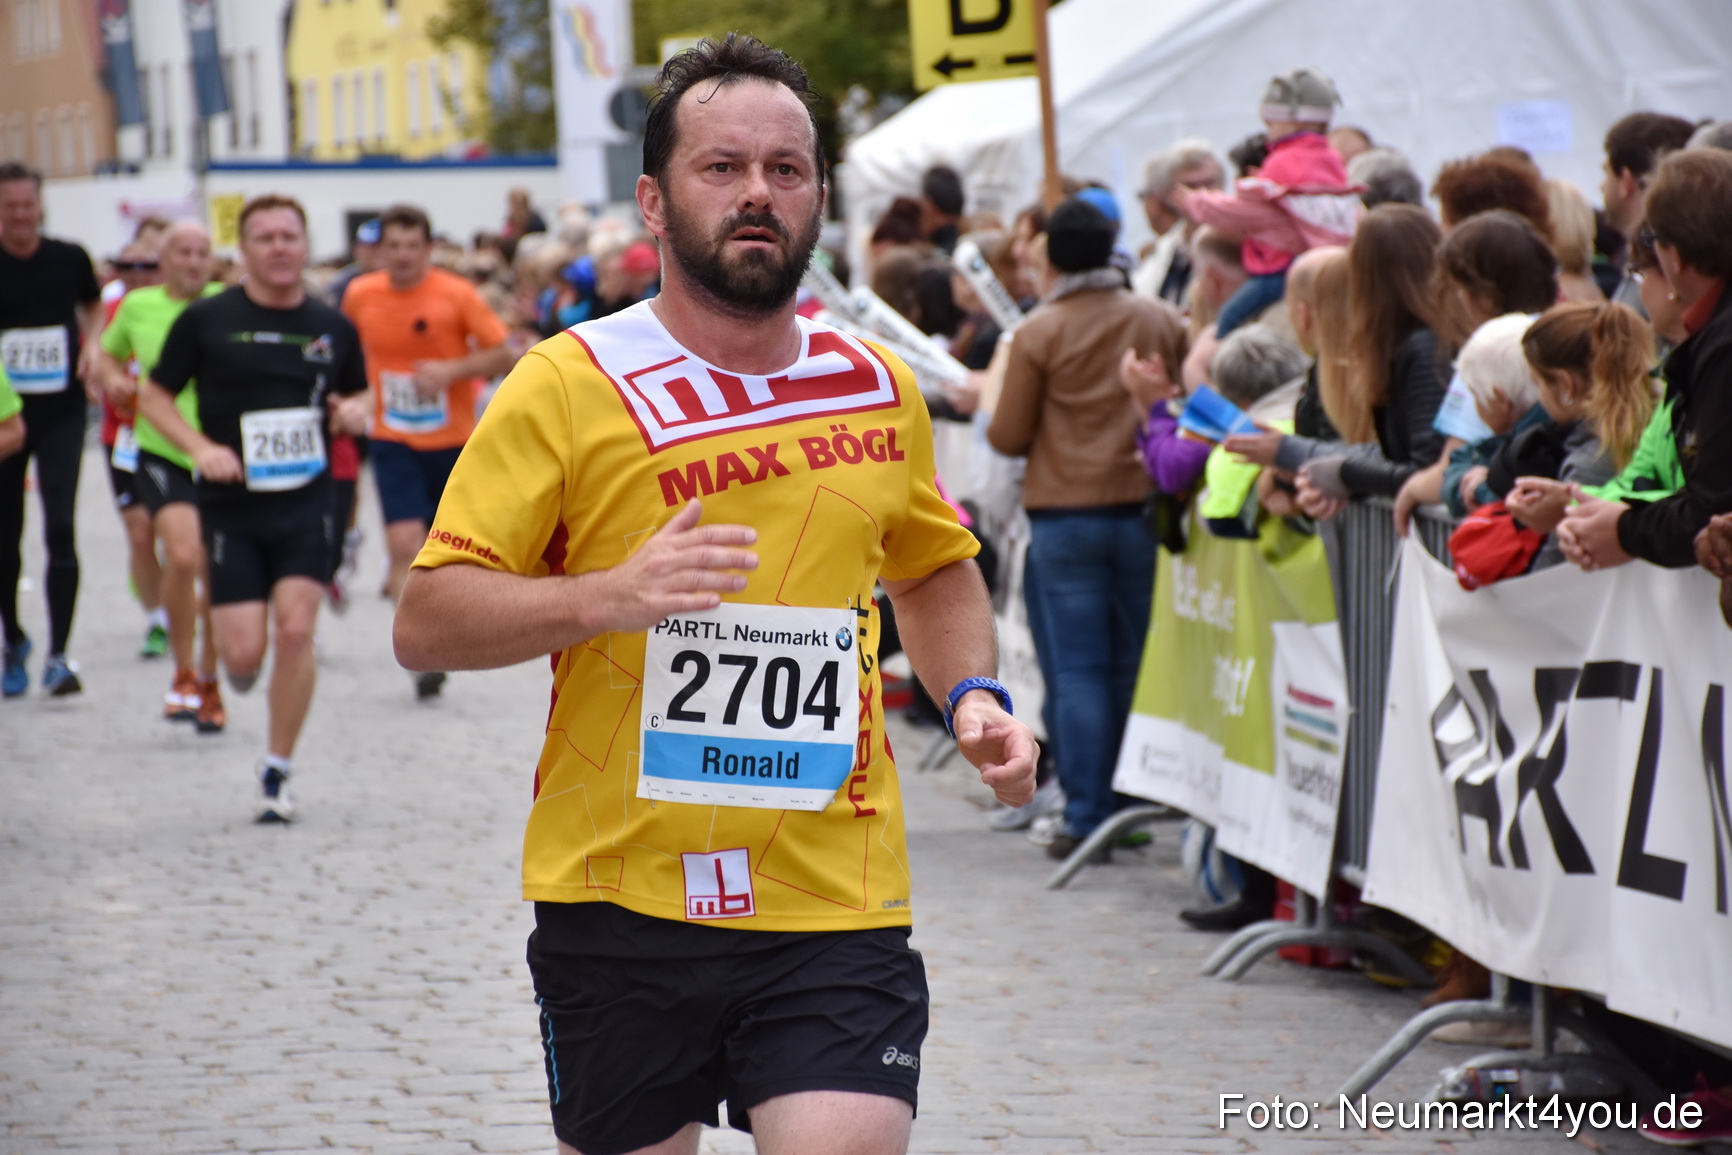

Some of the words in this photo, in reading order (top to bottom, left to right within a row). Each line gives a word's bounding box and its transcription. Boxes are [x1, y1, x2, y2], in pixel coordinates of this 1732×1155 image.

[657, 442, 792, 508] MAX
[798, 424, 905, 471] BÖGL
[655, 618, 728, 640] PARTL
[734, 624, 829, 647] Neumarkt
[665, 650, 841, 731] 2704
[702, 746, 800, 780] Ronald
